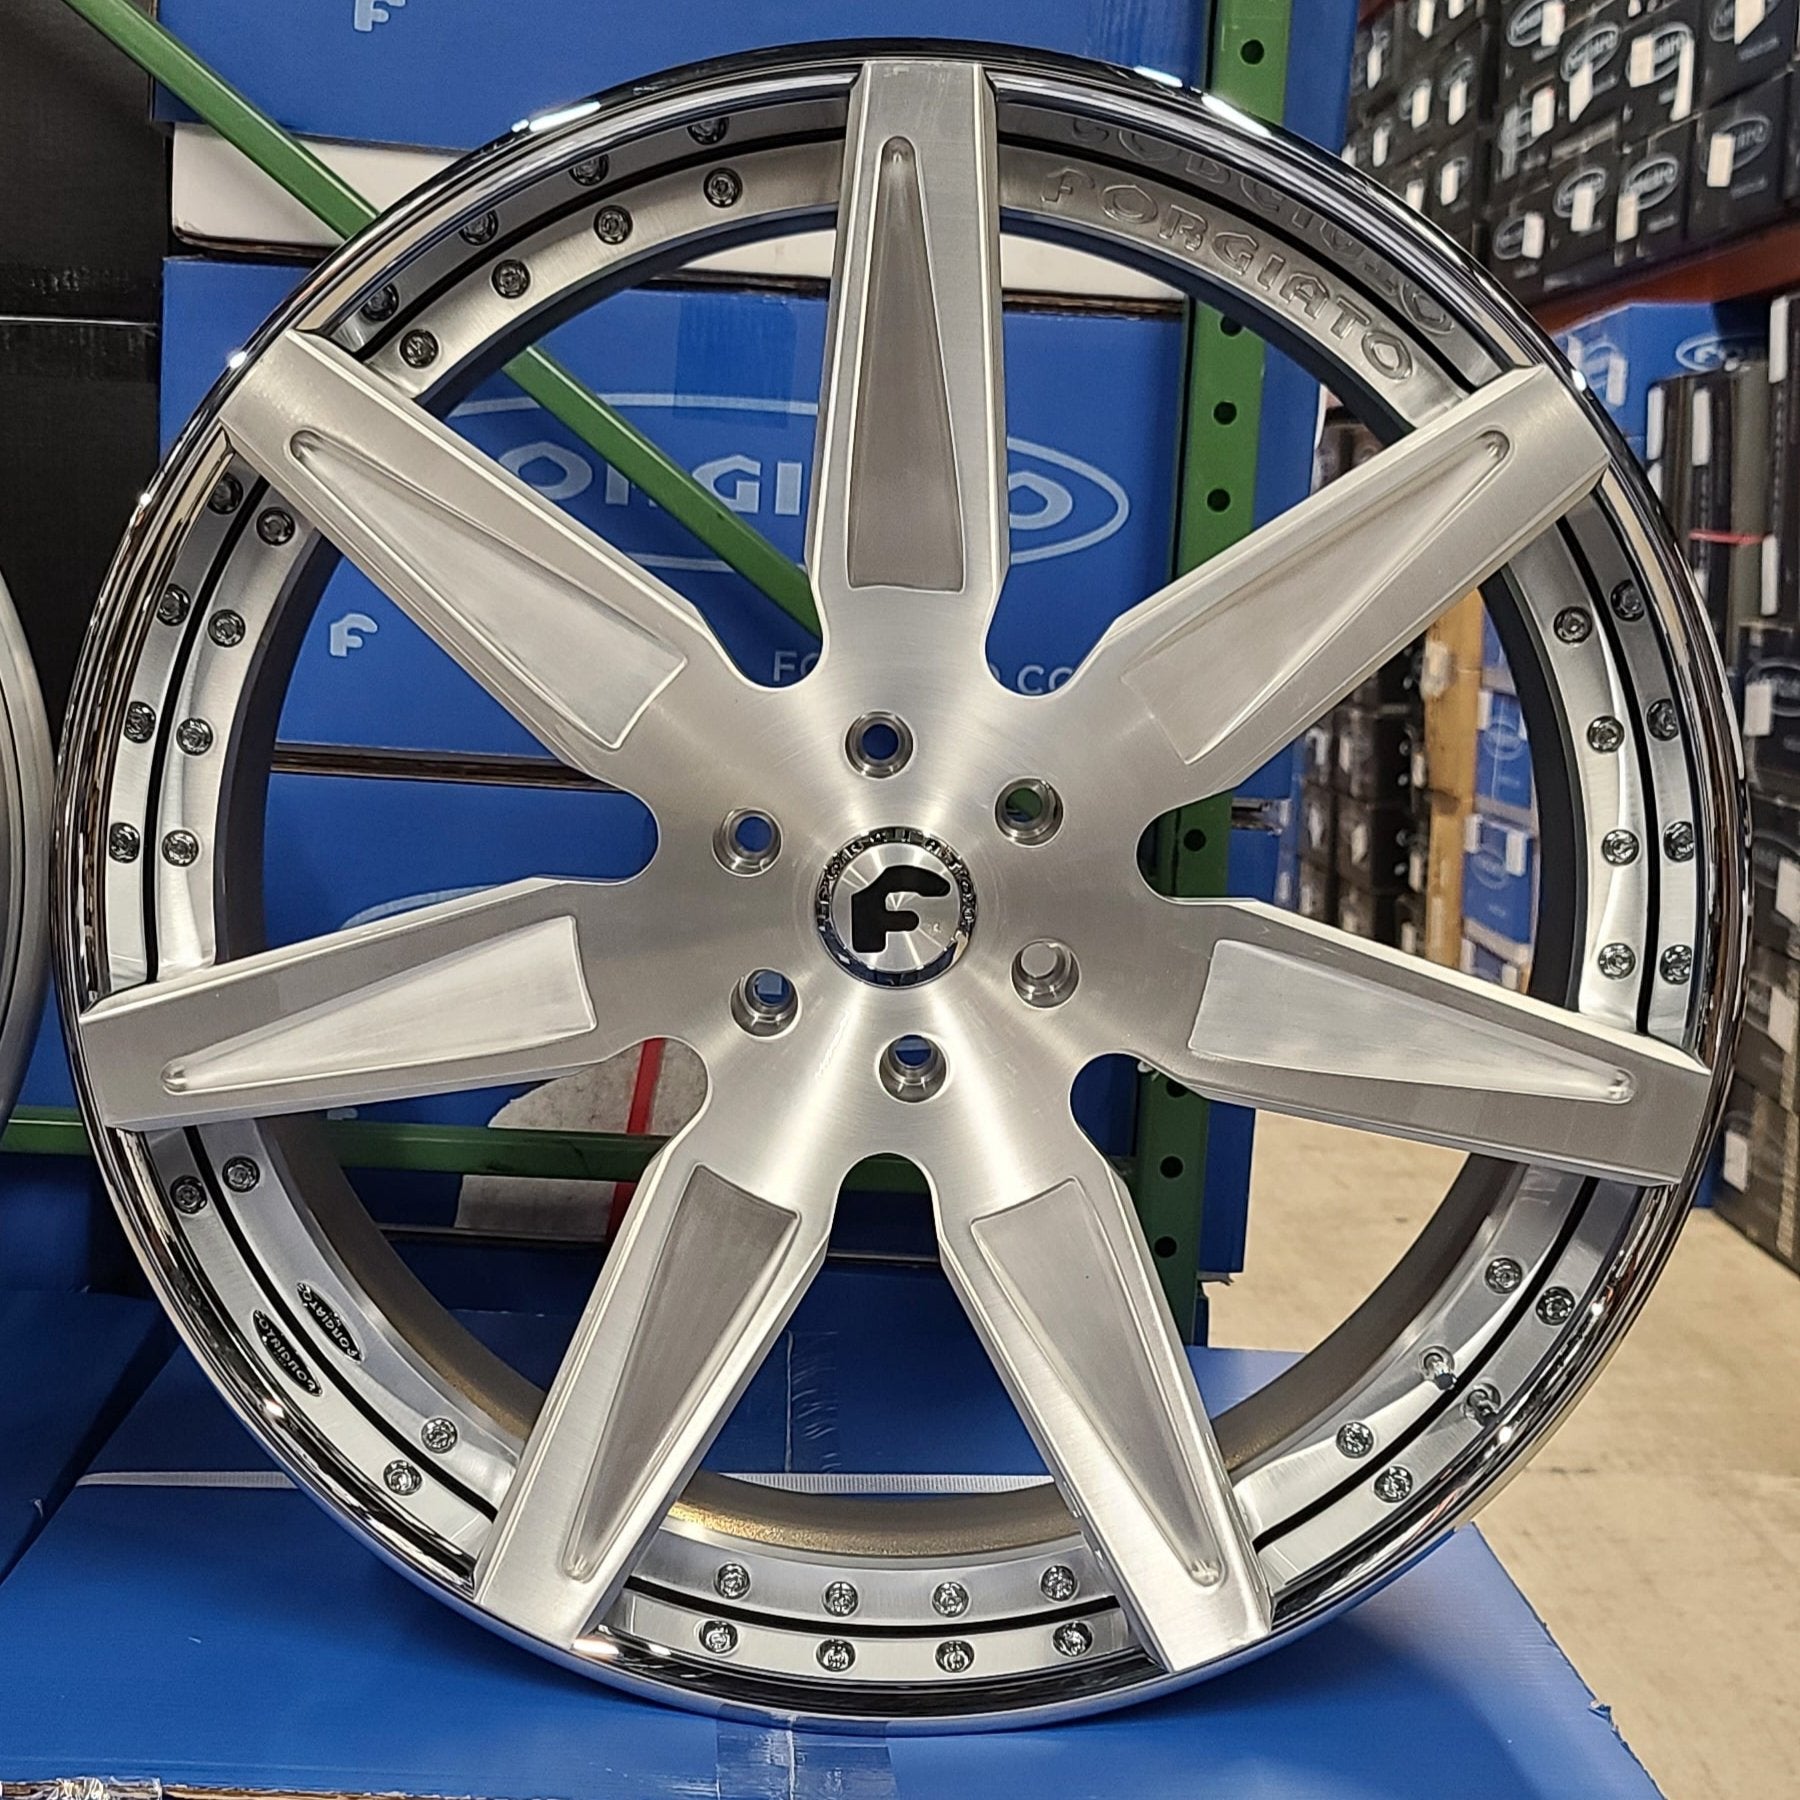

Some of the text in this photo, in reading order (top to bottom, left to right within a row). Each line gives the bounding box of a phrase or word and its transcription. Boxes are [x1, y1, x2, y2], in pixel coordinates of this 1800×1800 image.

[1041, 168, 1412, 381] FORGIATO
[330, 613, 378, 657] F
[851, 865, 951, 953] F
